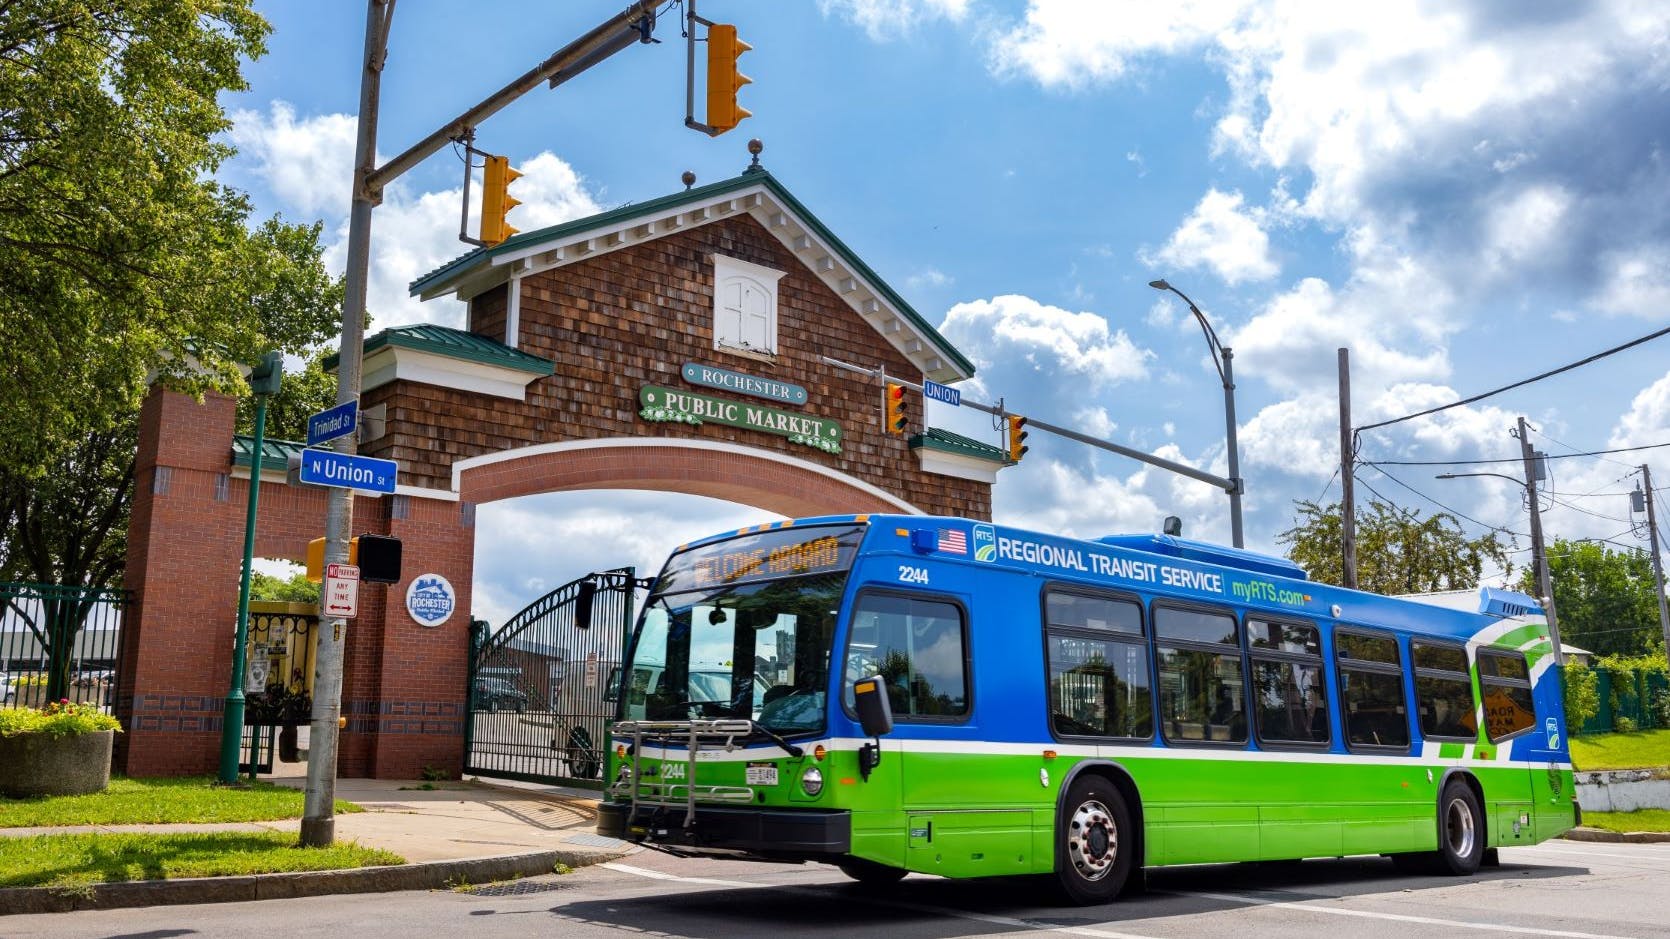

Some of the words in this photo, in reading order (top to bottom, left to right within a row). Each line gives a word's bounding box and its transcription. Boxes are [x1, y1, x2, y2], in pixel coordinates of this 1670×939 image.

[702, 369, 790, 399] ROCHESTER
[927, 382, 958, 405] UNION
[314, 413, 342, 437] Trinidad
[343, 415, 350, 427] St
[665, 392, 738, 421] PUBLIC
[746, 408, 822, 438] MARKET
[313, 460, 321, 474] N
[325, 459, 373, 484] Union
[377, 476, 385, 486] St
[976, 530, 993, 542] RTS
[329, 567, 338, 576] NO
[695, 549, 765, 583] WELCOME
[768, 536, 840, 573] ABOARD
[998, 537, 1088, 572] REGIONAL
[1089, 553, 1157, 582] TRANSIT
[1162, 567, 1222, 593] SERVICE
[898, 565, 929, 584] 2244
[412, 598, 450, 610] ROCHESTER
[1232, 580, 1305, 606] myRTS.com
